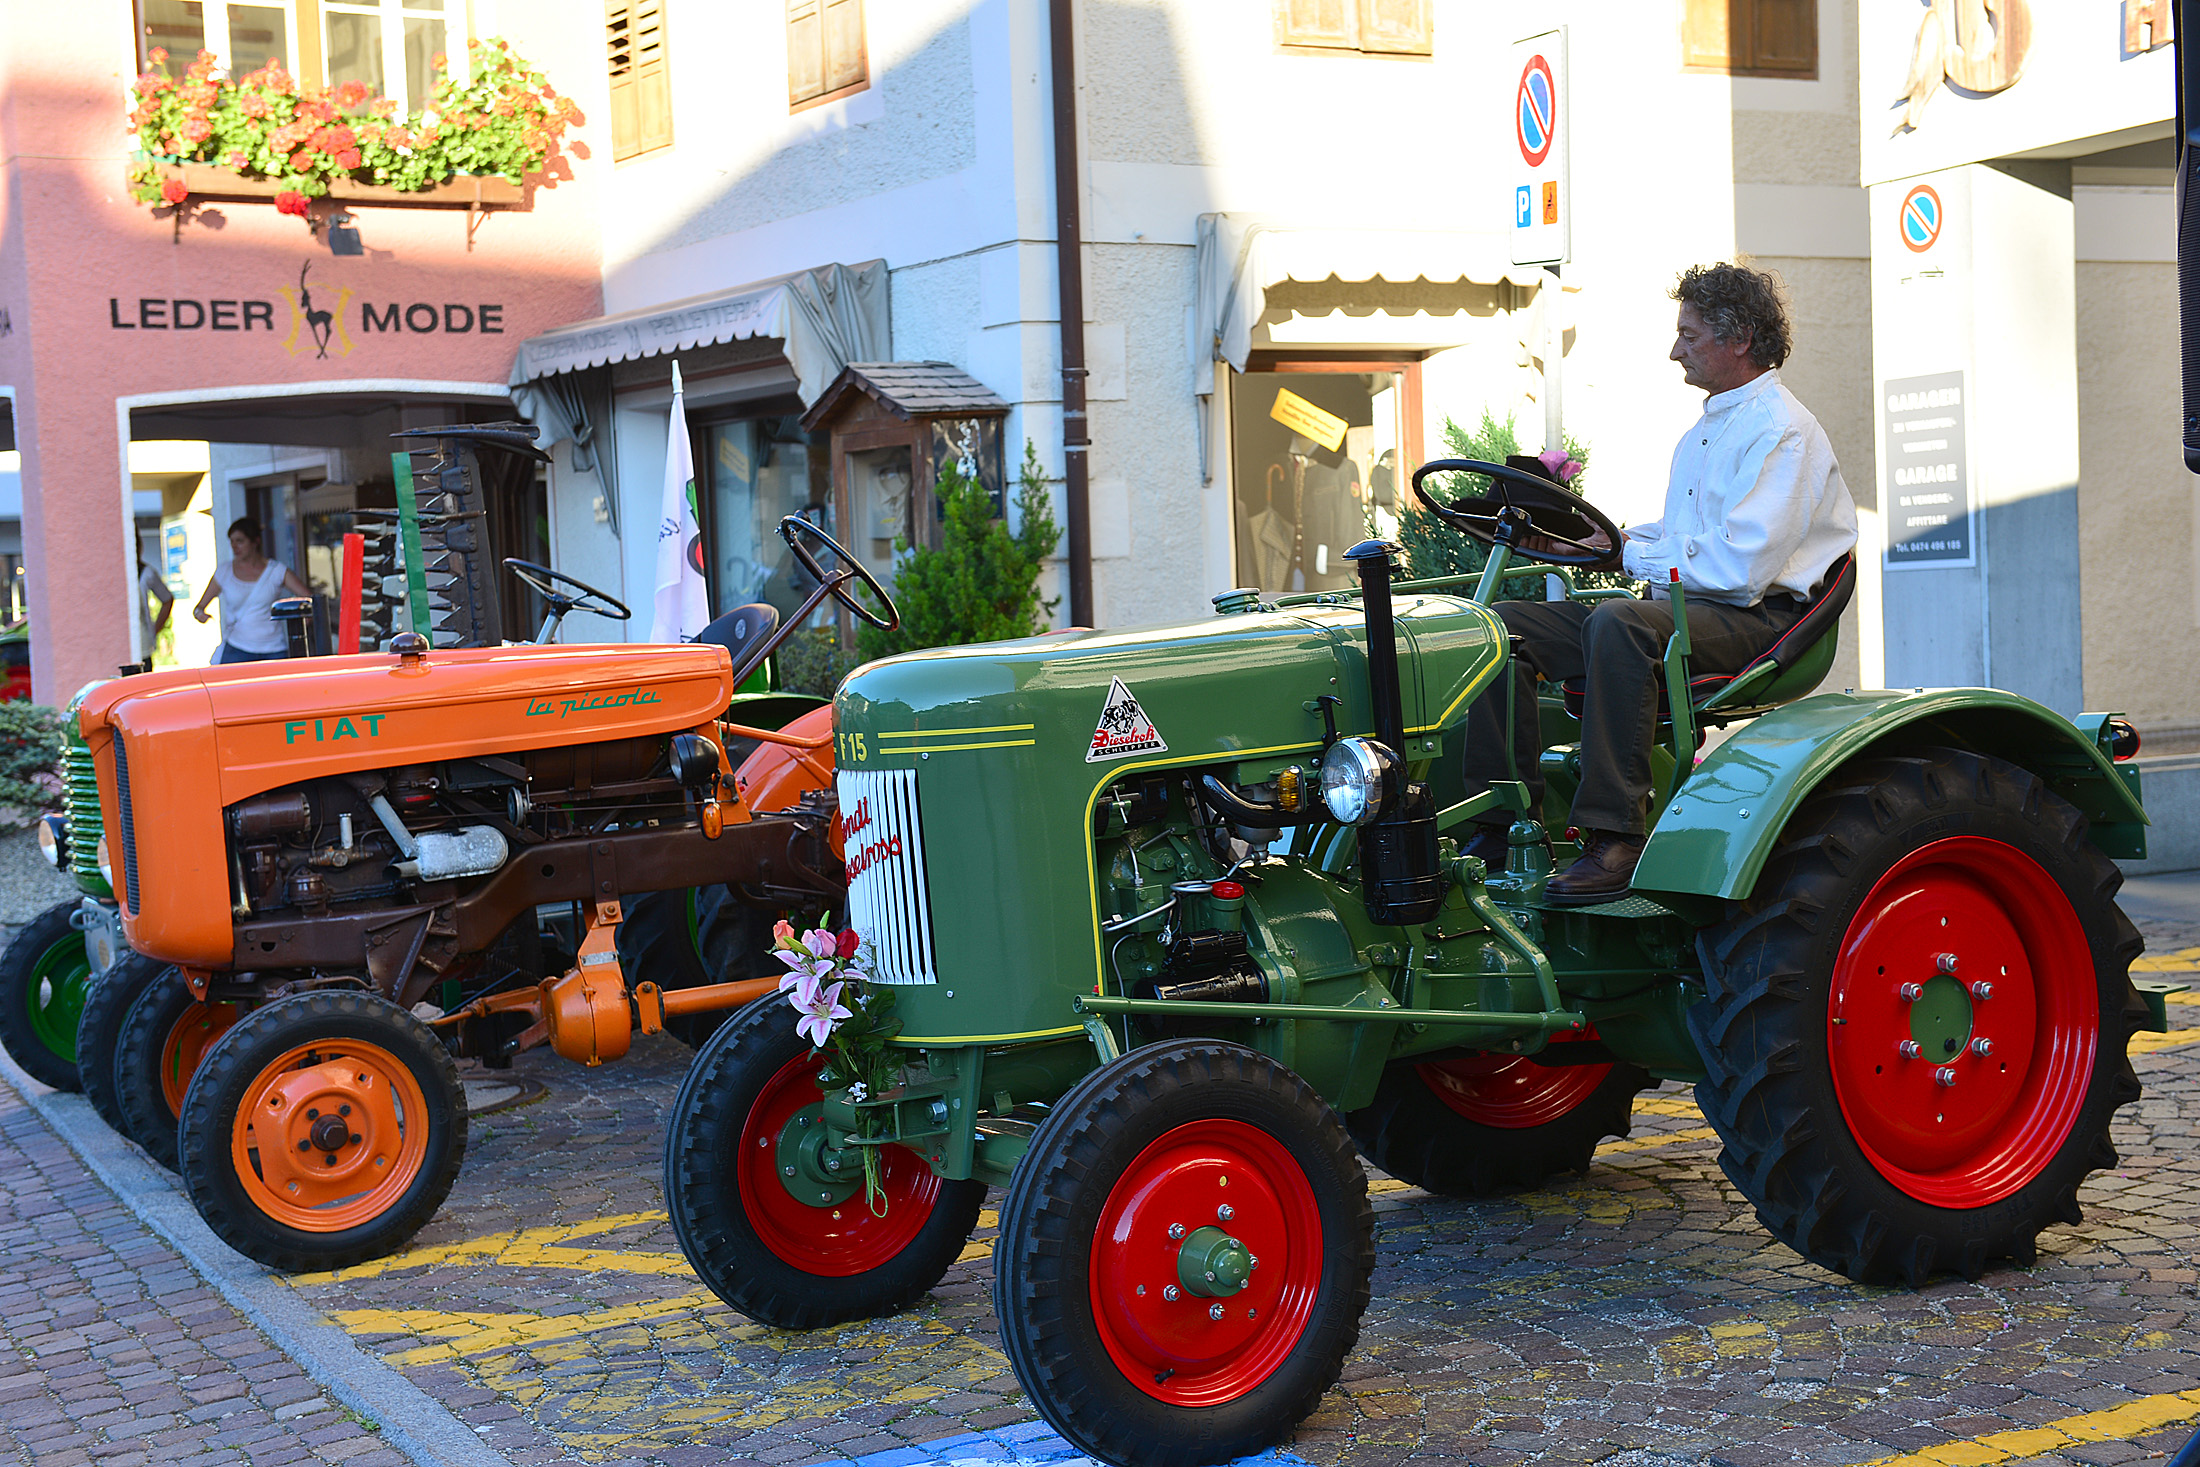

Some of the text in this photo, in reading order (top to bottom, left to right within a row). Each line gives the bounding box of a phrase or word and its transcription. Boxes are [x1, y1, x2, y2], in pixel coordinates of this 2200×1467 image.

[1517, 190, 1530, 224] P
[110, 298, 504, 334] LEDER MODE
[1887, 387, 1961, 413] GARAGEN
[1895, 463, 1957, 486] GARAGE
[560, 687, 663, 719] piccola
[285, 714, 386, 745] FIAT
[1091, 725, 1155, 748] Dieselroß
[1098, 742, 1156, 756] SCHLEPPER
